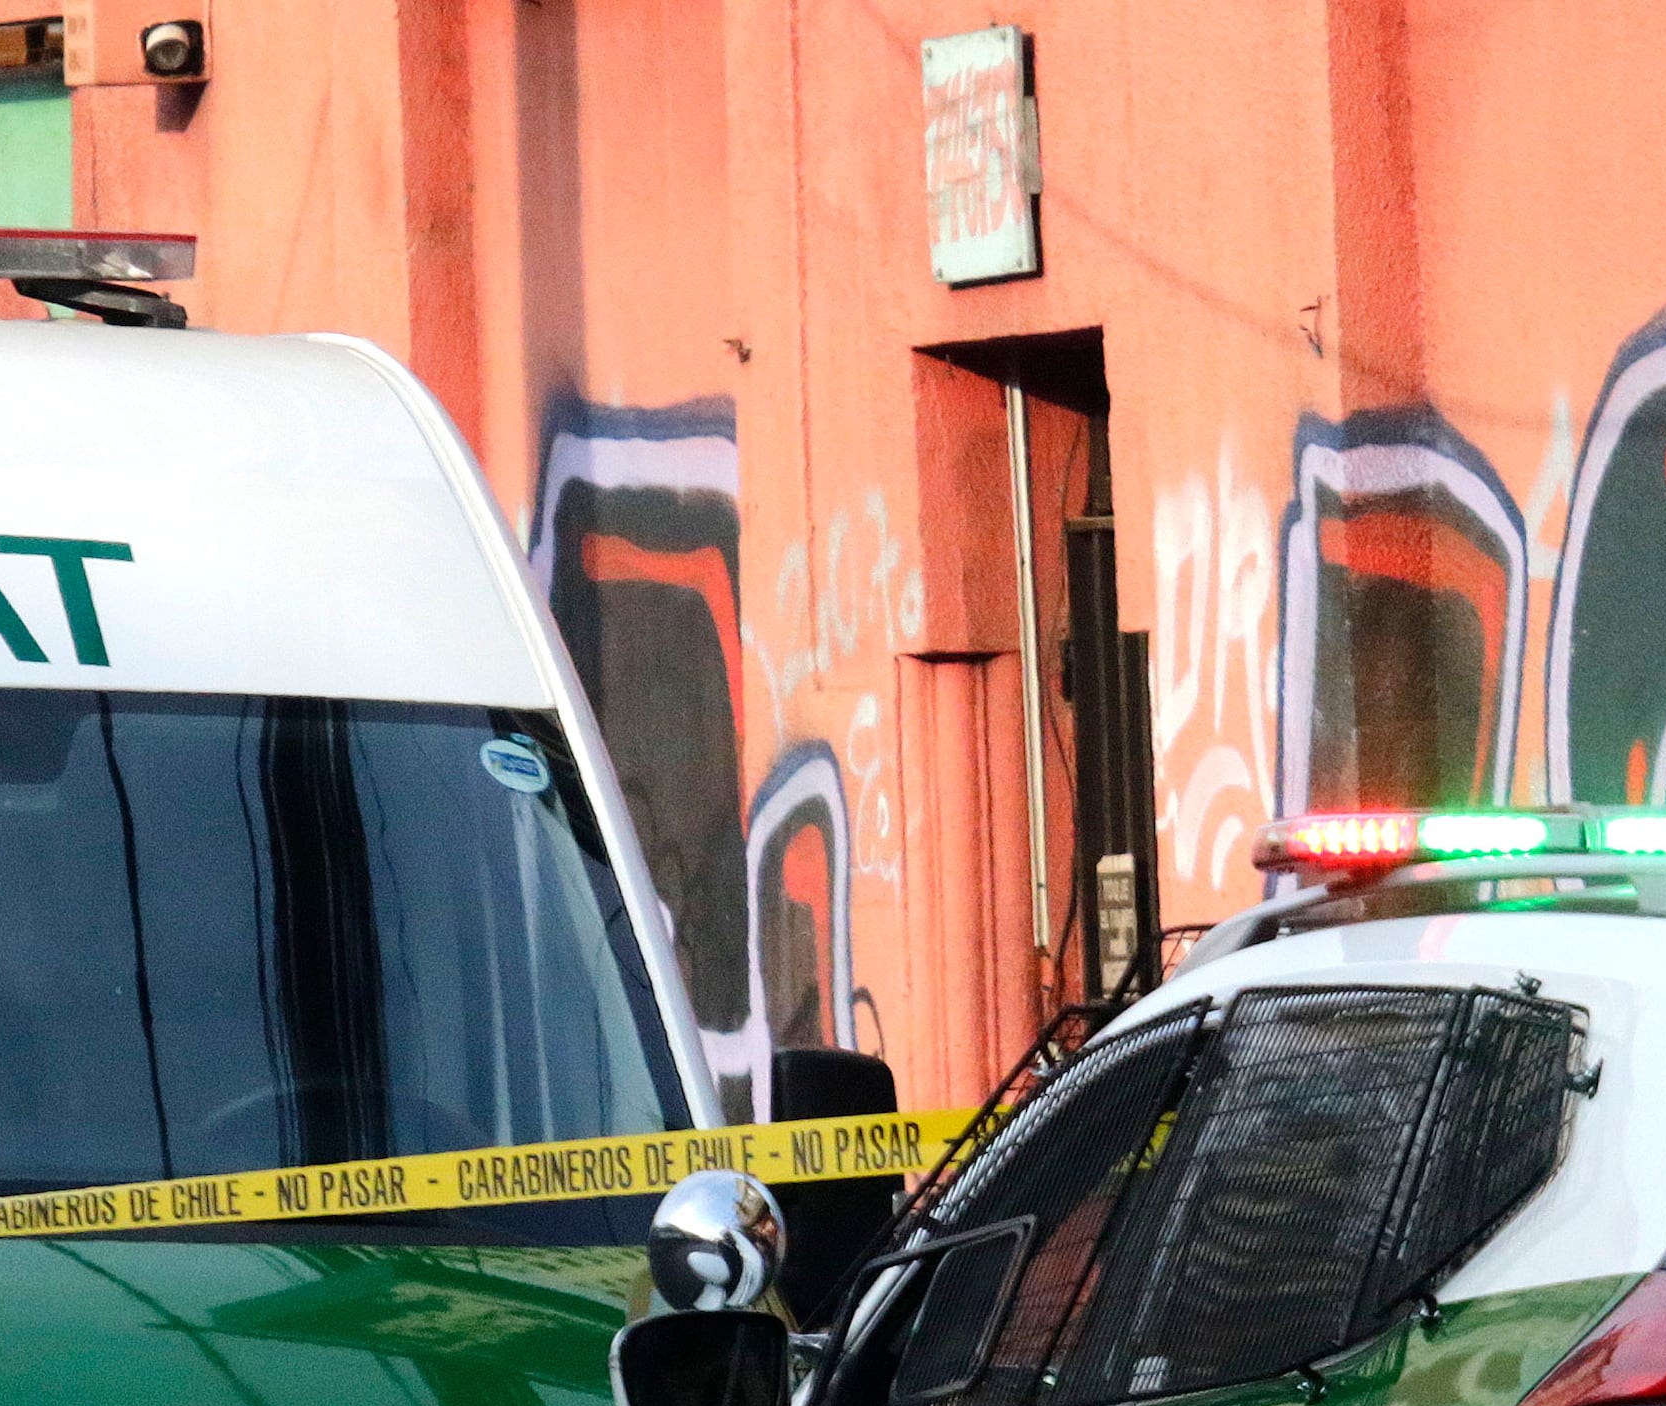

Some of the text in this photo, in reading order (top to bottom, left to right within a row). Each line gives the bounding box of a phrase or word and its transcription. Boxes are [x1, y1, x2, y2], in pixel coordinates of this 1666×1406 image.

[130, 1185, 160, 1222] DE
[170, 1178, 242, 1218] CHILE
[277, 1173, 309, 1213] NO
[319, 1164, 407, 1210] PASAR
[457, 1147, 633, 1202] CARABINEROS
[644, 1142, 675, 1186] DE
[791, 1129, 825, 1177] NO
[835, 1121, 923, 1173] PASAR
